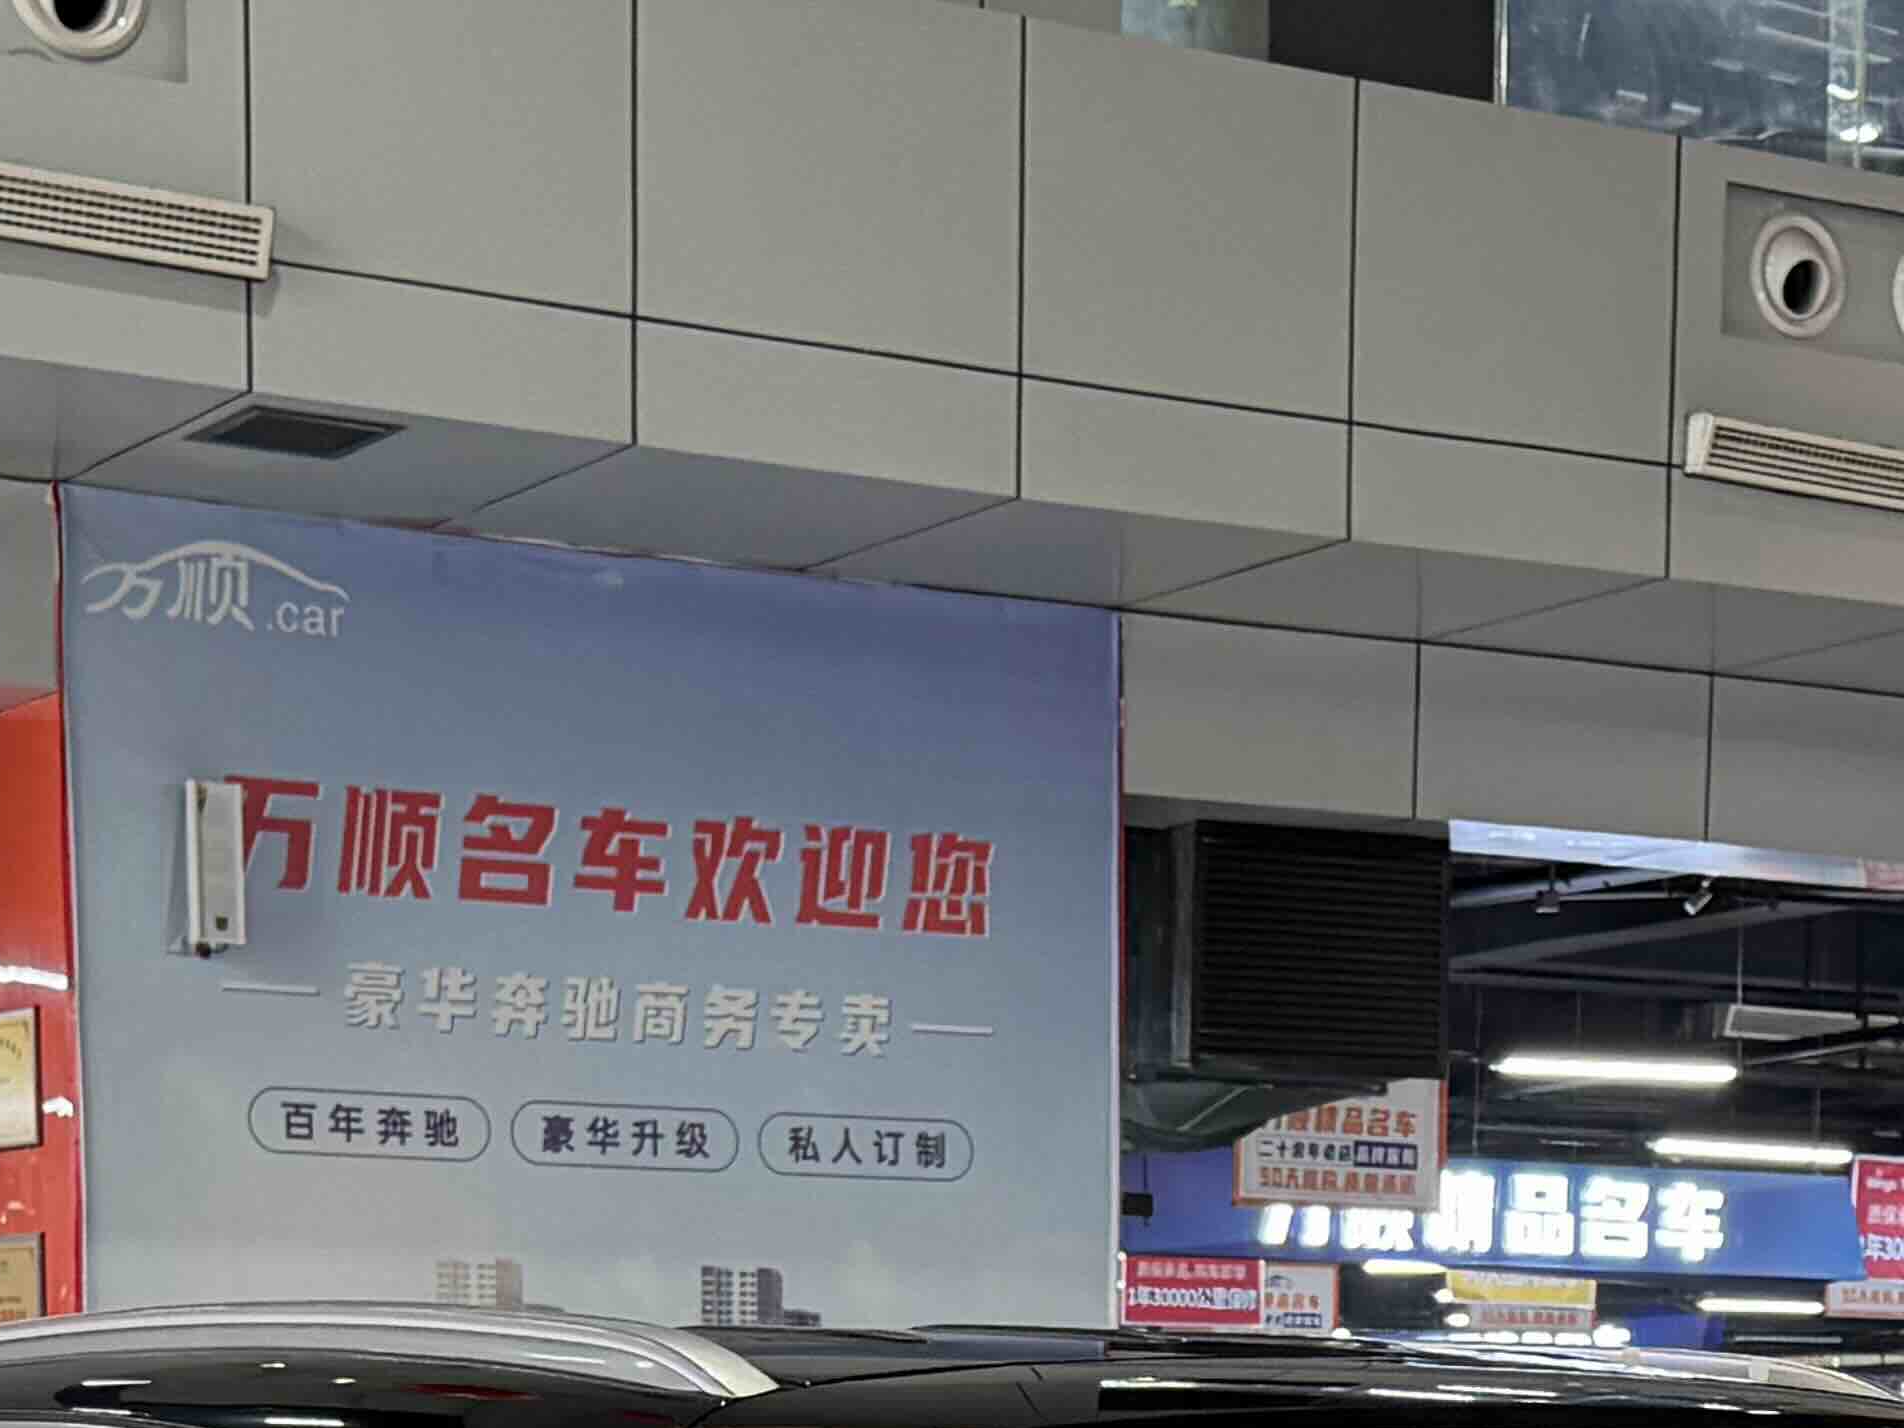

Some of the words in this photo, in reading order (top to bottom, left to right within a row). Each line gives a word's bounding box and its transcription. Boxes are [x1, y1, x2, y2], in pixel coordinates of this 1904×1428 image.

[266, 600, 345, 637] .car
[222, 772, 995, 936] 万顺名车欢迎您
[342, 960, 894, 1057] 豪华奔驰商务专卖
[280, 1101, 461, 1150] 百年奔驰
[540, 1113, 711, 1162] 豪华升级
[786, 1123, 948, 1171] 私人订制
